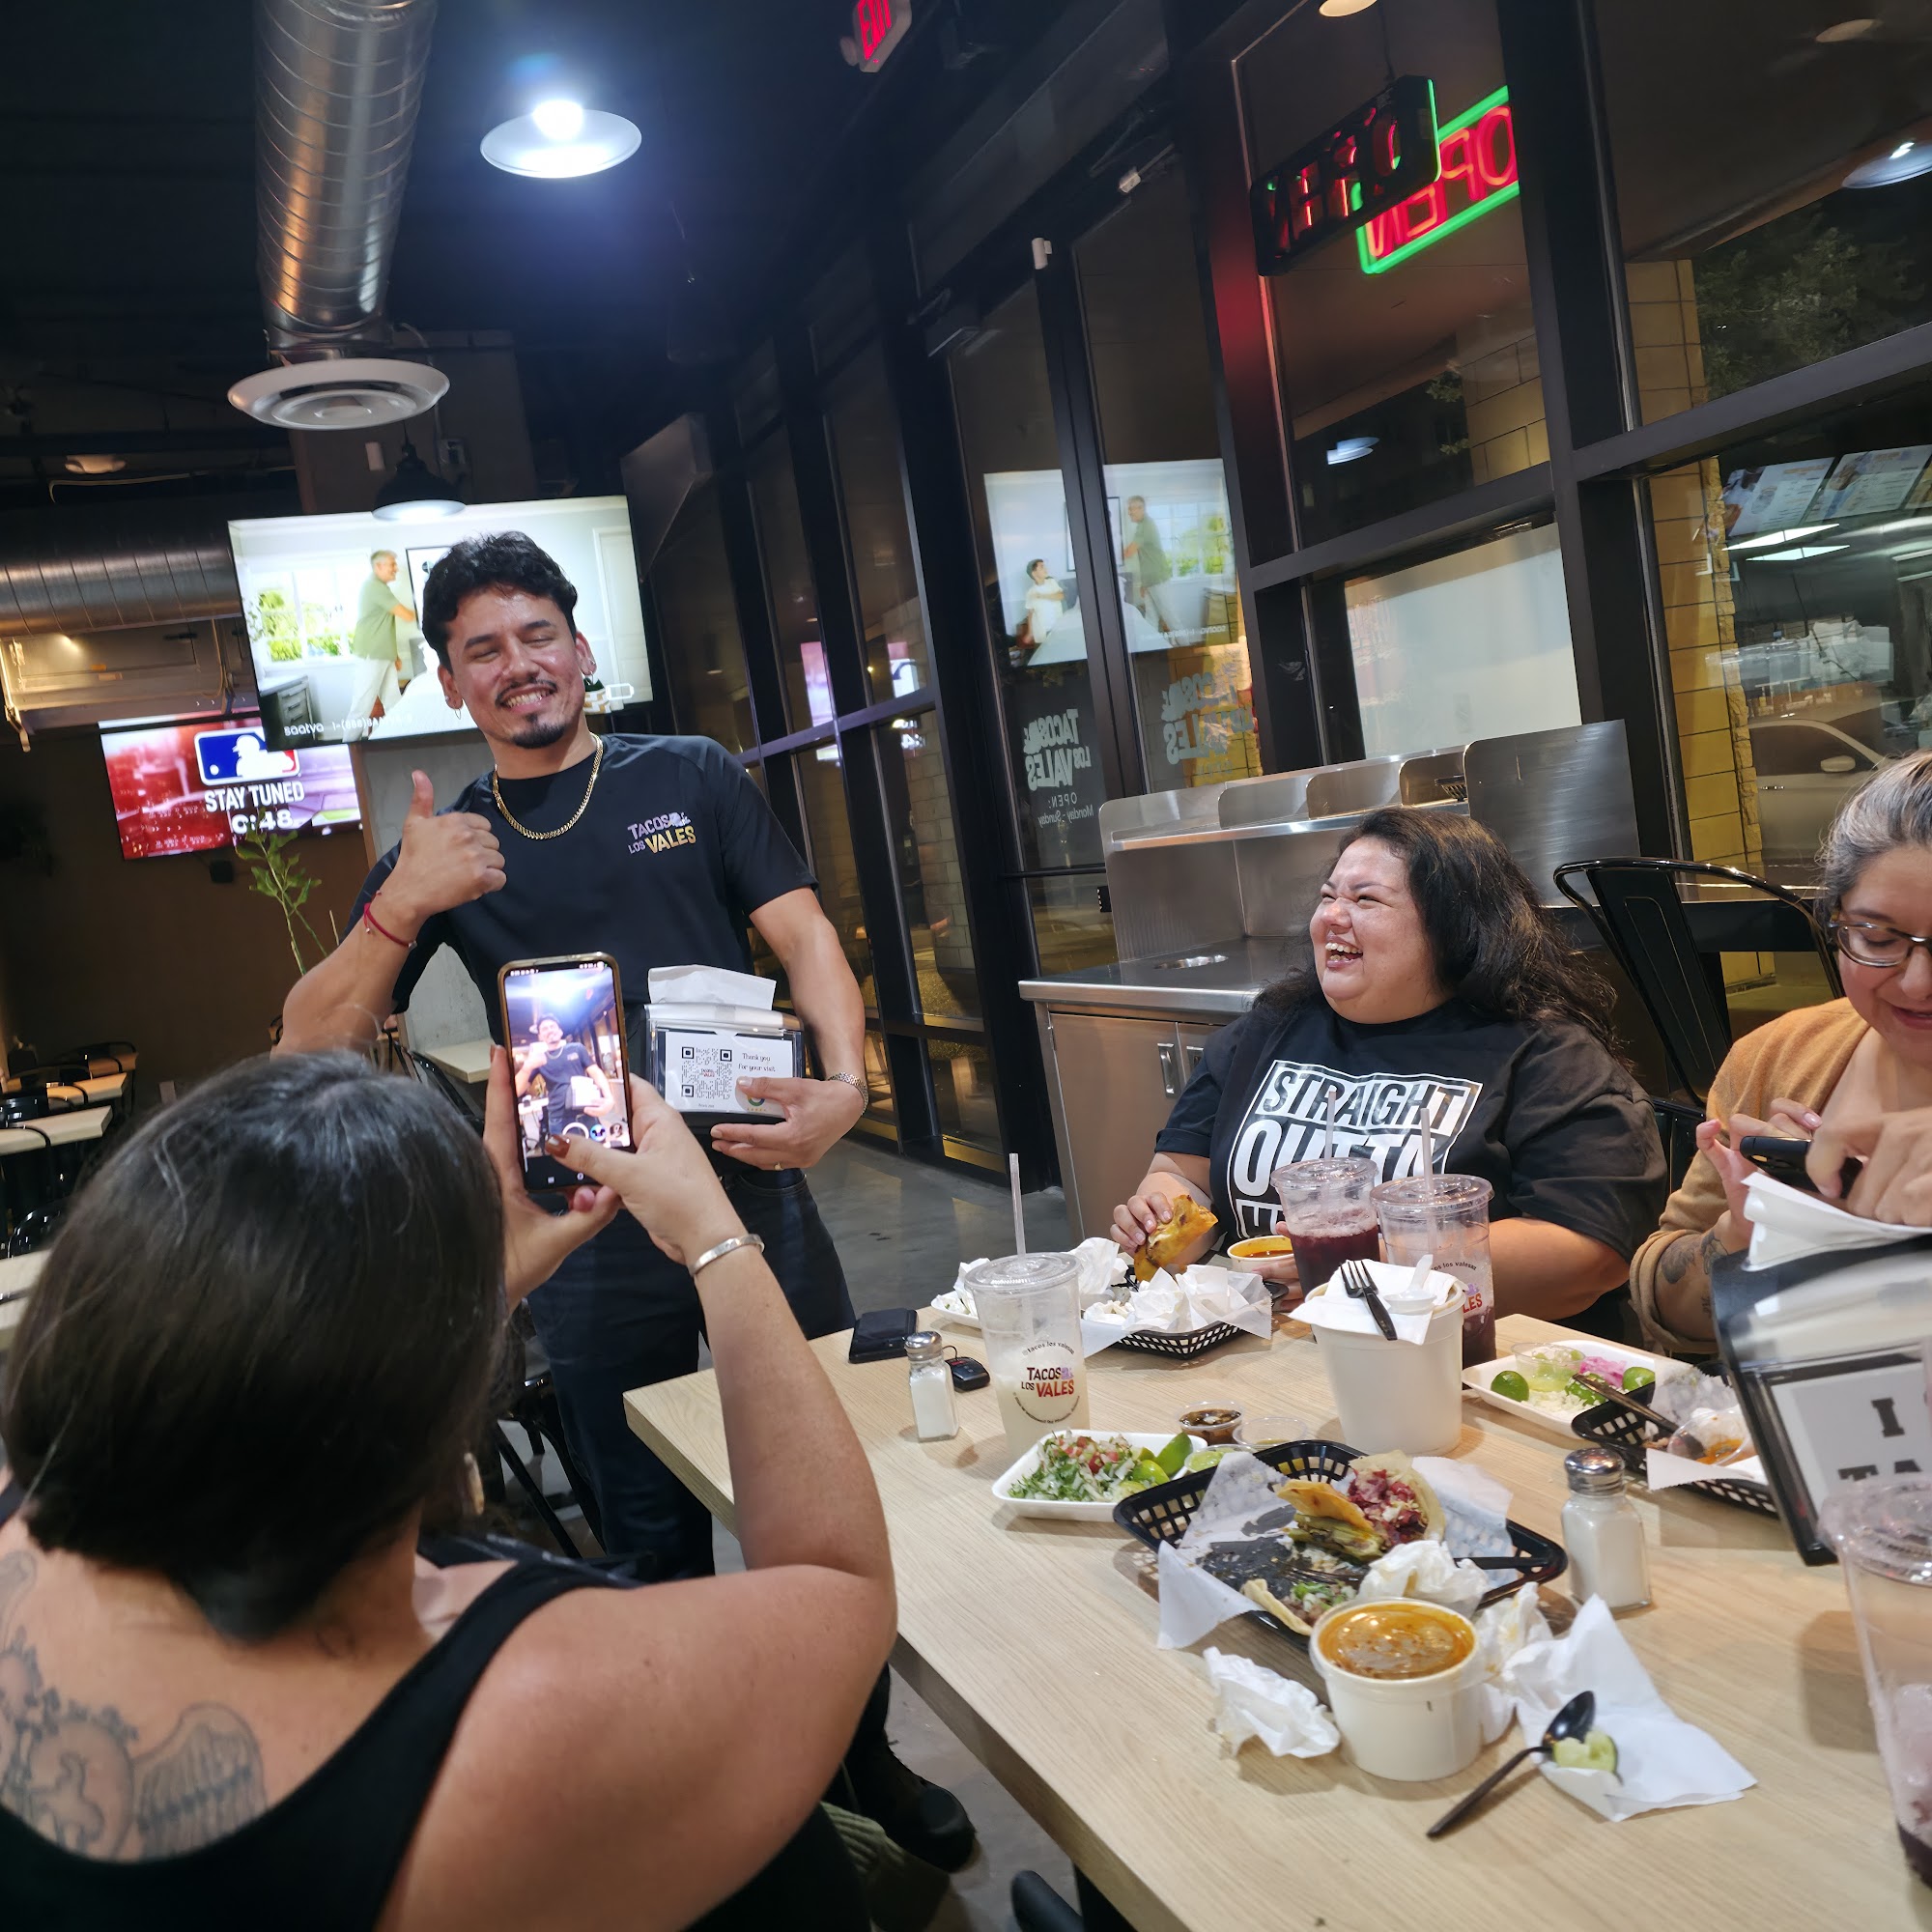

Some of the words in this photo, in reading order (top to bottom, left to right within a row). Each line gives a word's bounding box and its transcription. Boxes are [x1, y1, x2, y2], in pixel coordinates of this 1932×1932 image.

[204, 786, 246, 812] STAY
[247, 781, 305, 807] TUNED
[628, 814, 670, 840] TACOS
[628, 840, 646, 854] LOS
[644, 825, 696, 854] VALES
[1262, 1069, 1466, 1130] STRAIGHT
[1021, 1381, 1035, 1391] LOS
[1036, 1378, 1074, 1398] VALES
[1027, 1367, 1062, 1381] TACOS
[1870, 1397, 1905, 1437] I
